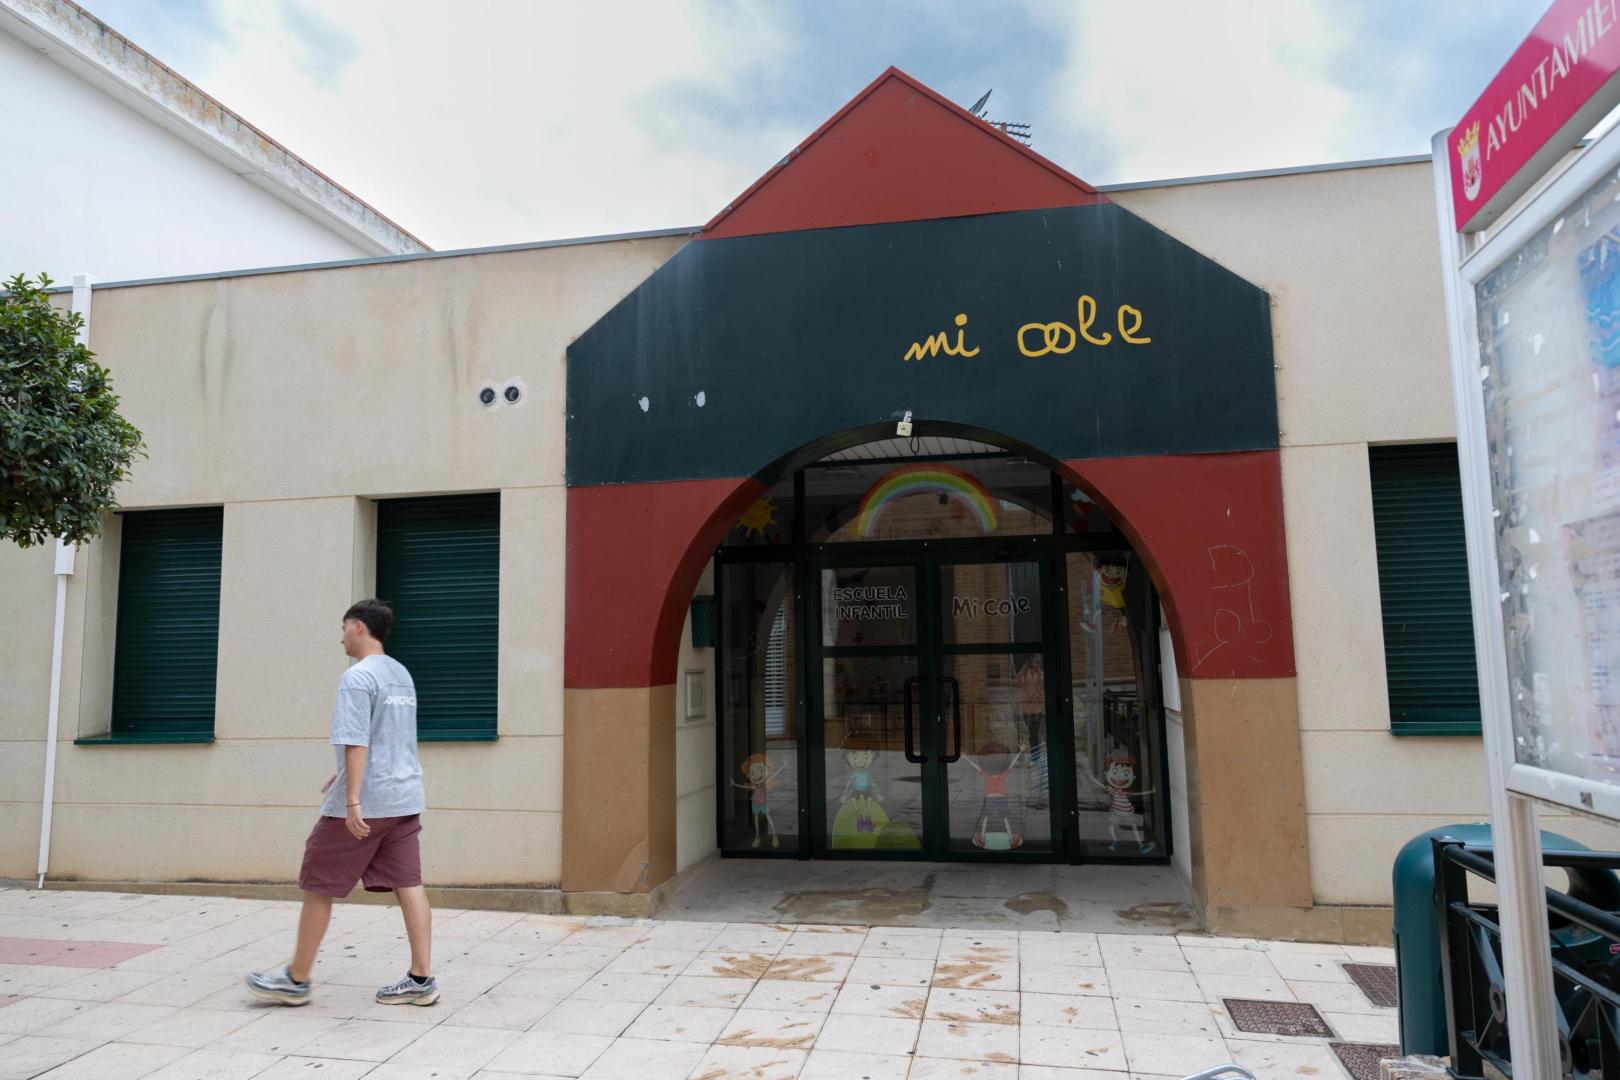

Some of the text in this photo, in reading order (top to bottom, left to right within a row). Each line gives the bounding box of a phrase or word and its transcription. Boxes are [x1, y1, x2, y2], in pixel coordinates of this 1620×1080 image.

[904, 313, 981, 361] mi
[833, 586, 907, 601] ESCUELA
[835, 604, 908, 620] INFANTIL
[952, 596, 978, 618] Mi
